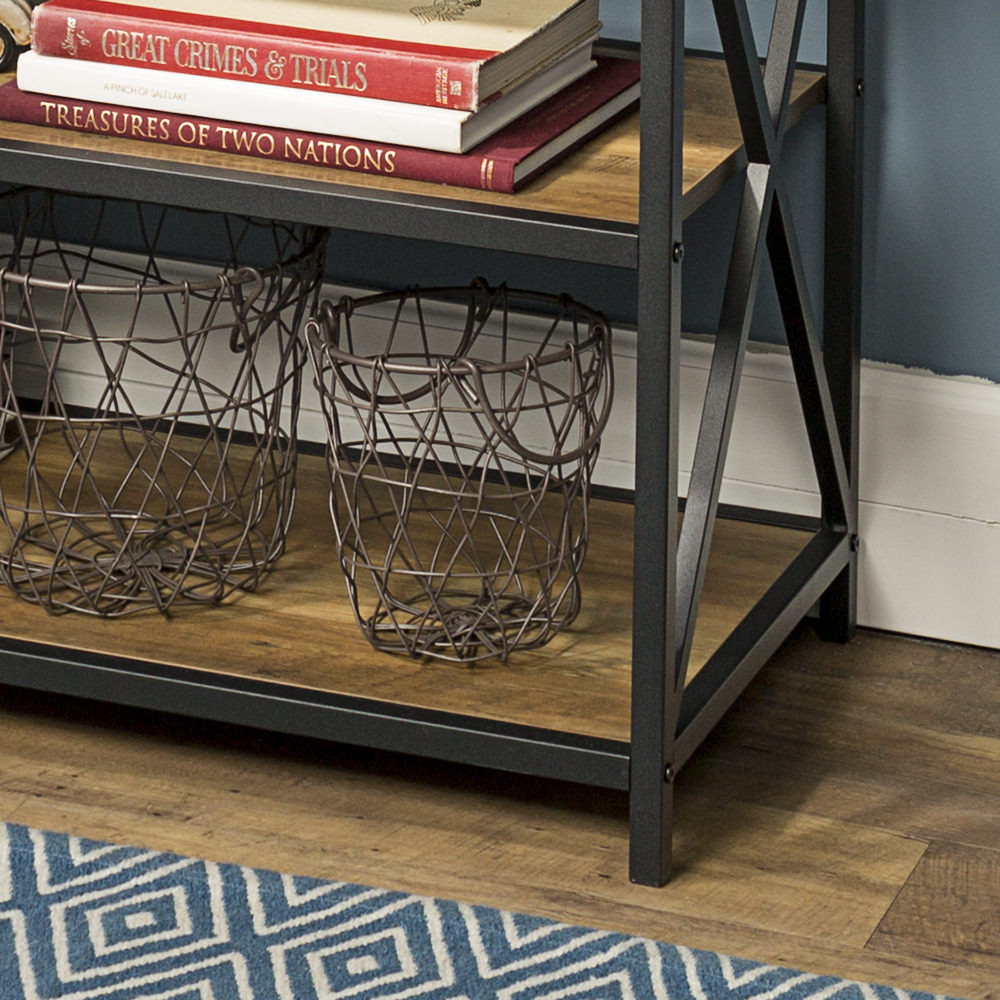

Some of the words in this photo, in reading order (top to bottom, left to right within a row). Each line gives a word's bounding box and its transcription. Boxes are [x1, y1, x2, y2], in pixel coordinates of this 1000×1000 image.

[101, 28, 171, 65] GREAT
[174, 38, 258, 78] CRIMES
[264, 50, 288, 81] &
[289, 53, 368, 92] TRIALS
[111, 83, 137, 95] PINCH
[138, 88, 150, 96] OF
[150, 89, 168, 99] SALT
[168, 91, 188, 101] LAKE
[40, 101, 170, 141] TREASURES
[177, 121, 210, 146] OF
[215, 126, 275, 155] TWO
[284, 136, 396, 173] NATIONS
